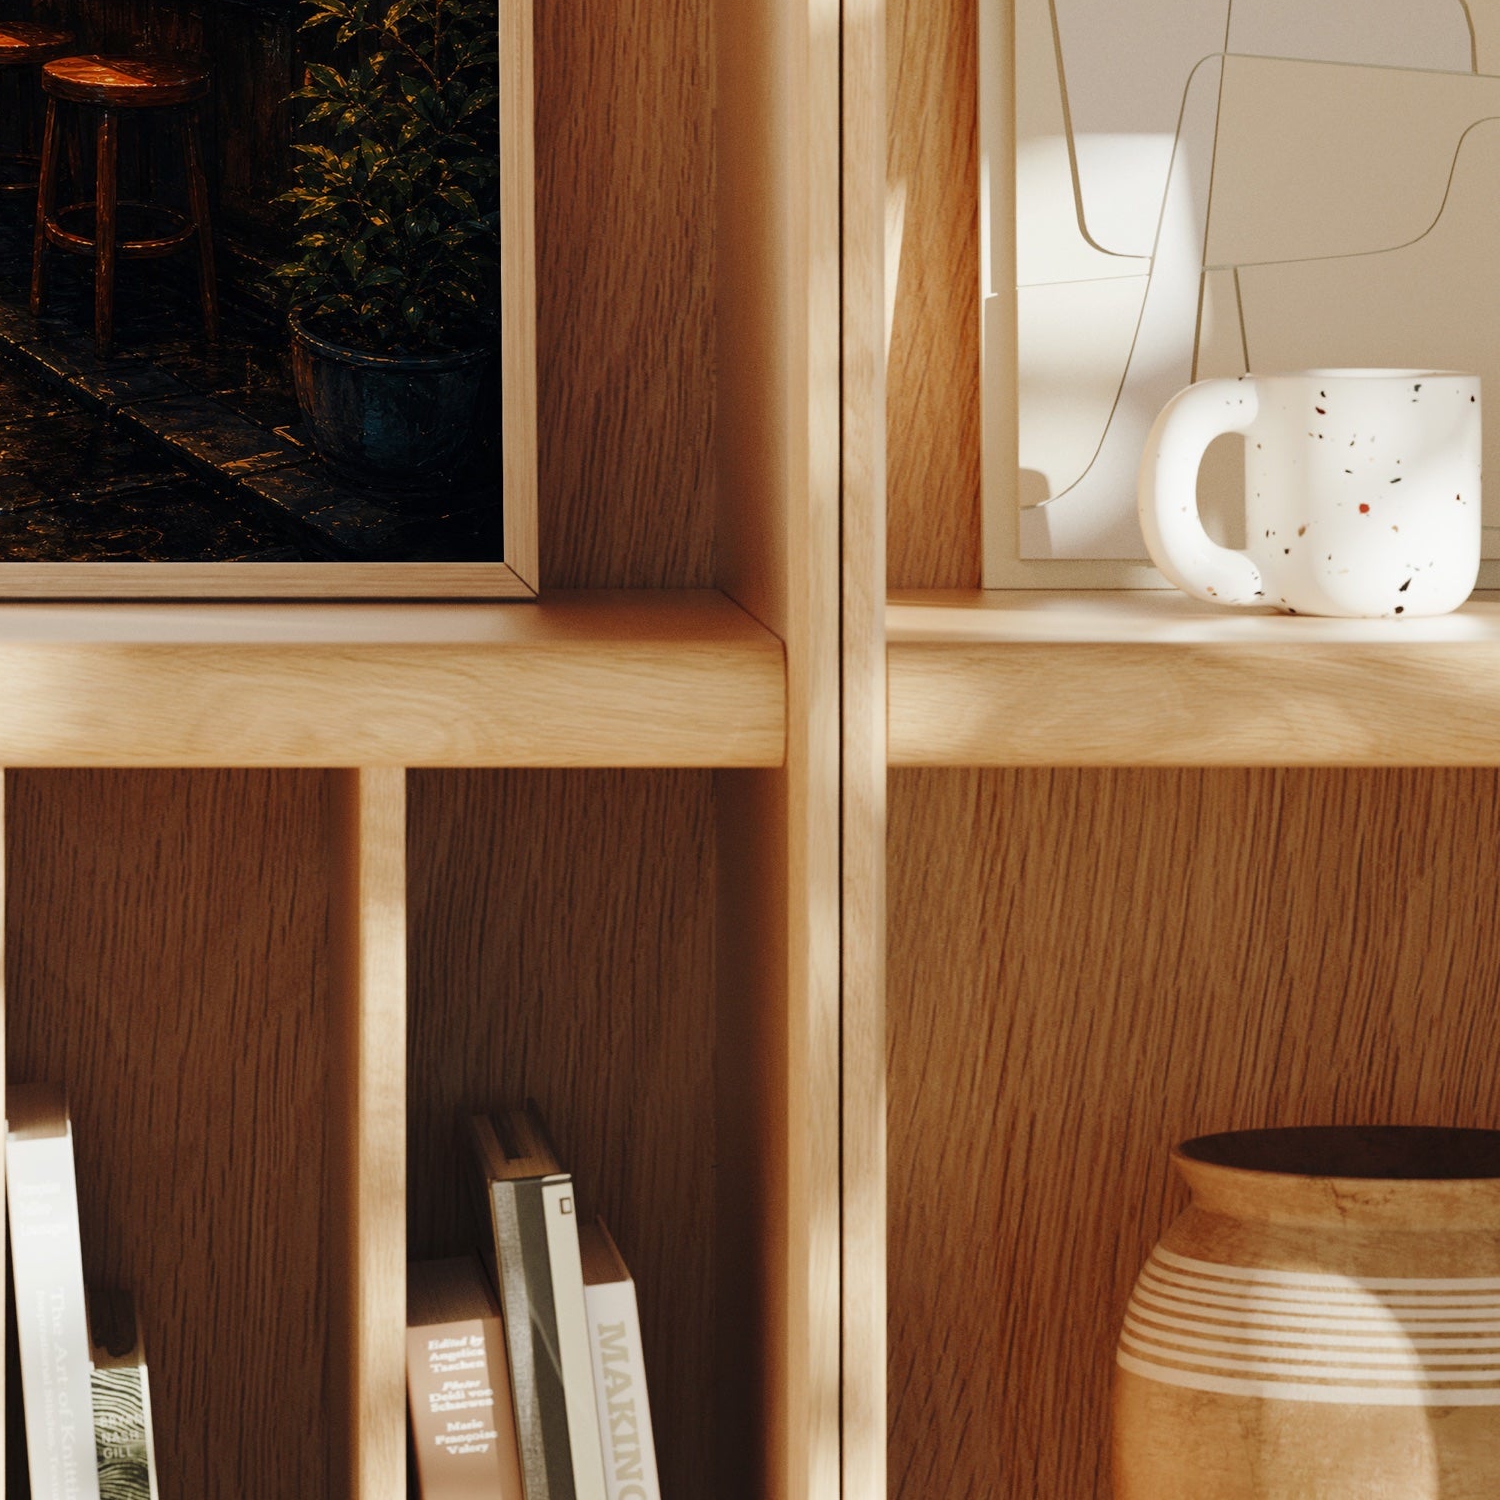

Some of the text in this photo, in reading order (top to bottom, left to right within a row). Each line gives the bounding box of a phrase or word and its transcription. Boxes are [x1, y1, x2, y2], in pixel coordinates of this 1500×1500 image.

[51, 1286, 65, 1336] The
[54, 1342, 69, 1383] Art
[58, 1392, 74, 1417] of
[103, 1443, 133, 1459] GILL
